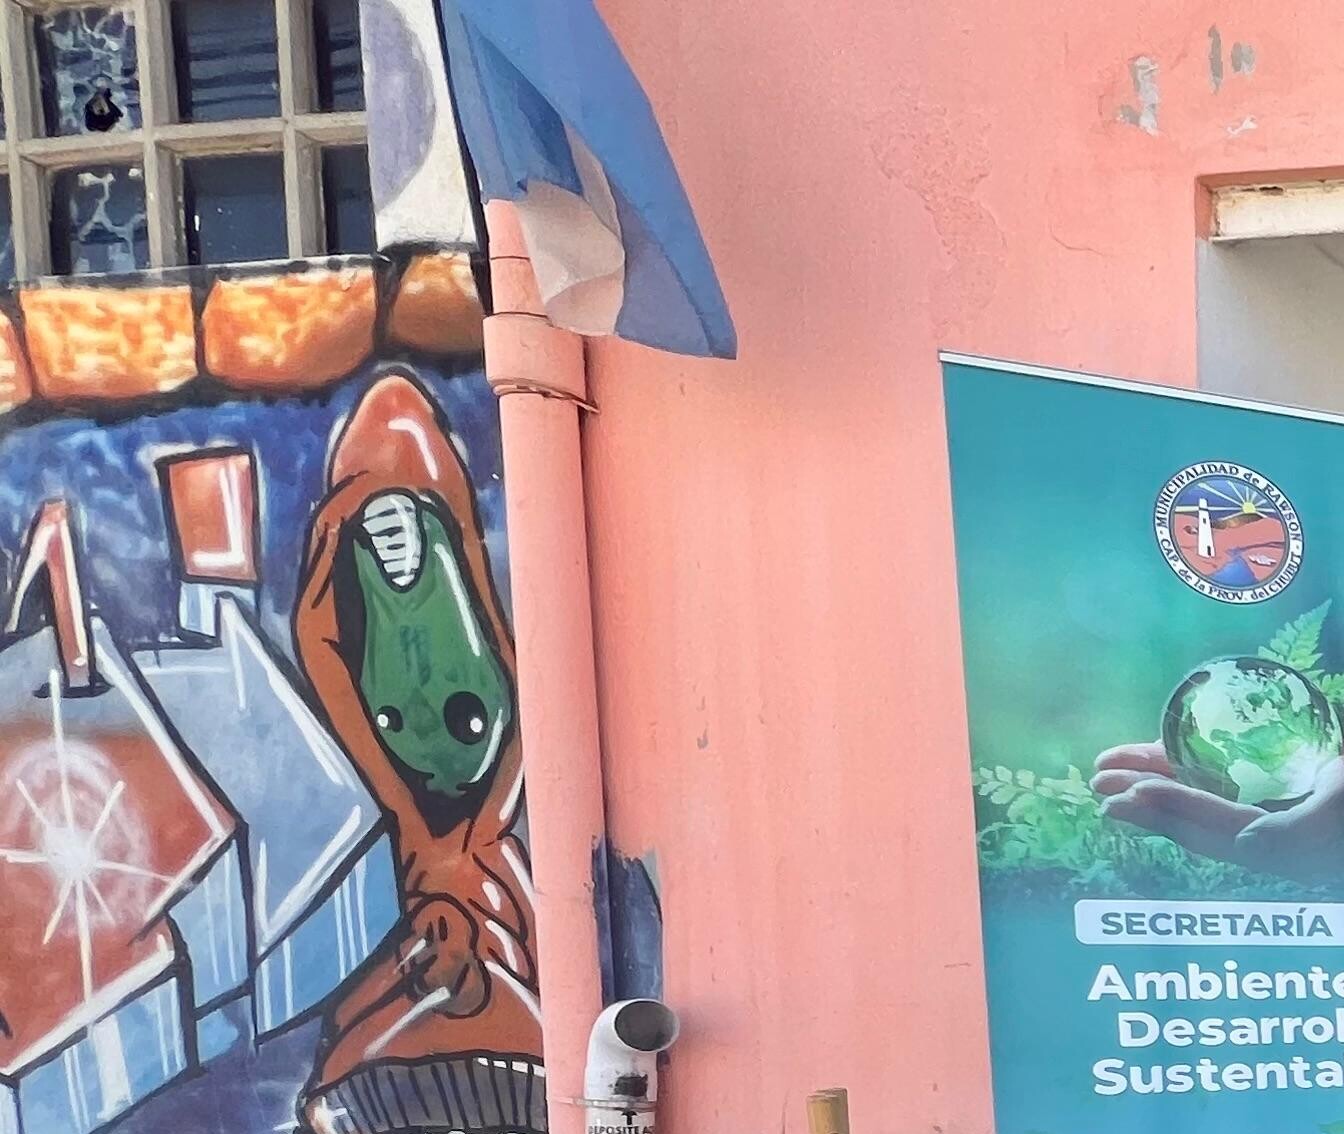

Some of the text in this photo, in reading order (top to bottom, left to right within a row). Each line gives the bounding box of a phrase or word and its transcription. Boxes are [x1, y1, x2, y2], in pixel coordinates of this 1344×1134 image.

[1156, 463, 1302, 542] MUNICIPALIDAD de RAWSON
[1178, 568, 1194, 583] de
[1195, 579, 1206, 592] la
[1250, 586, 1269, 601] del
[1268, 551, 1301, 594] CHUBUT
[1100, 907, 1333, 937] SECRETARÍA
